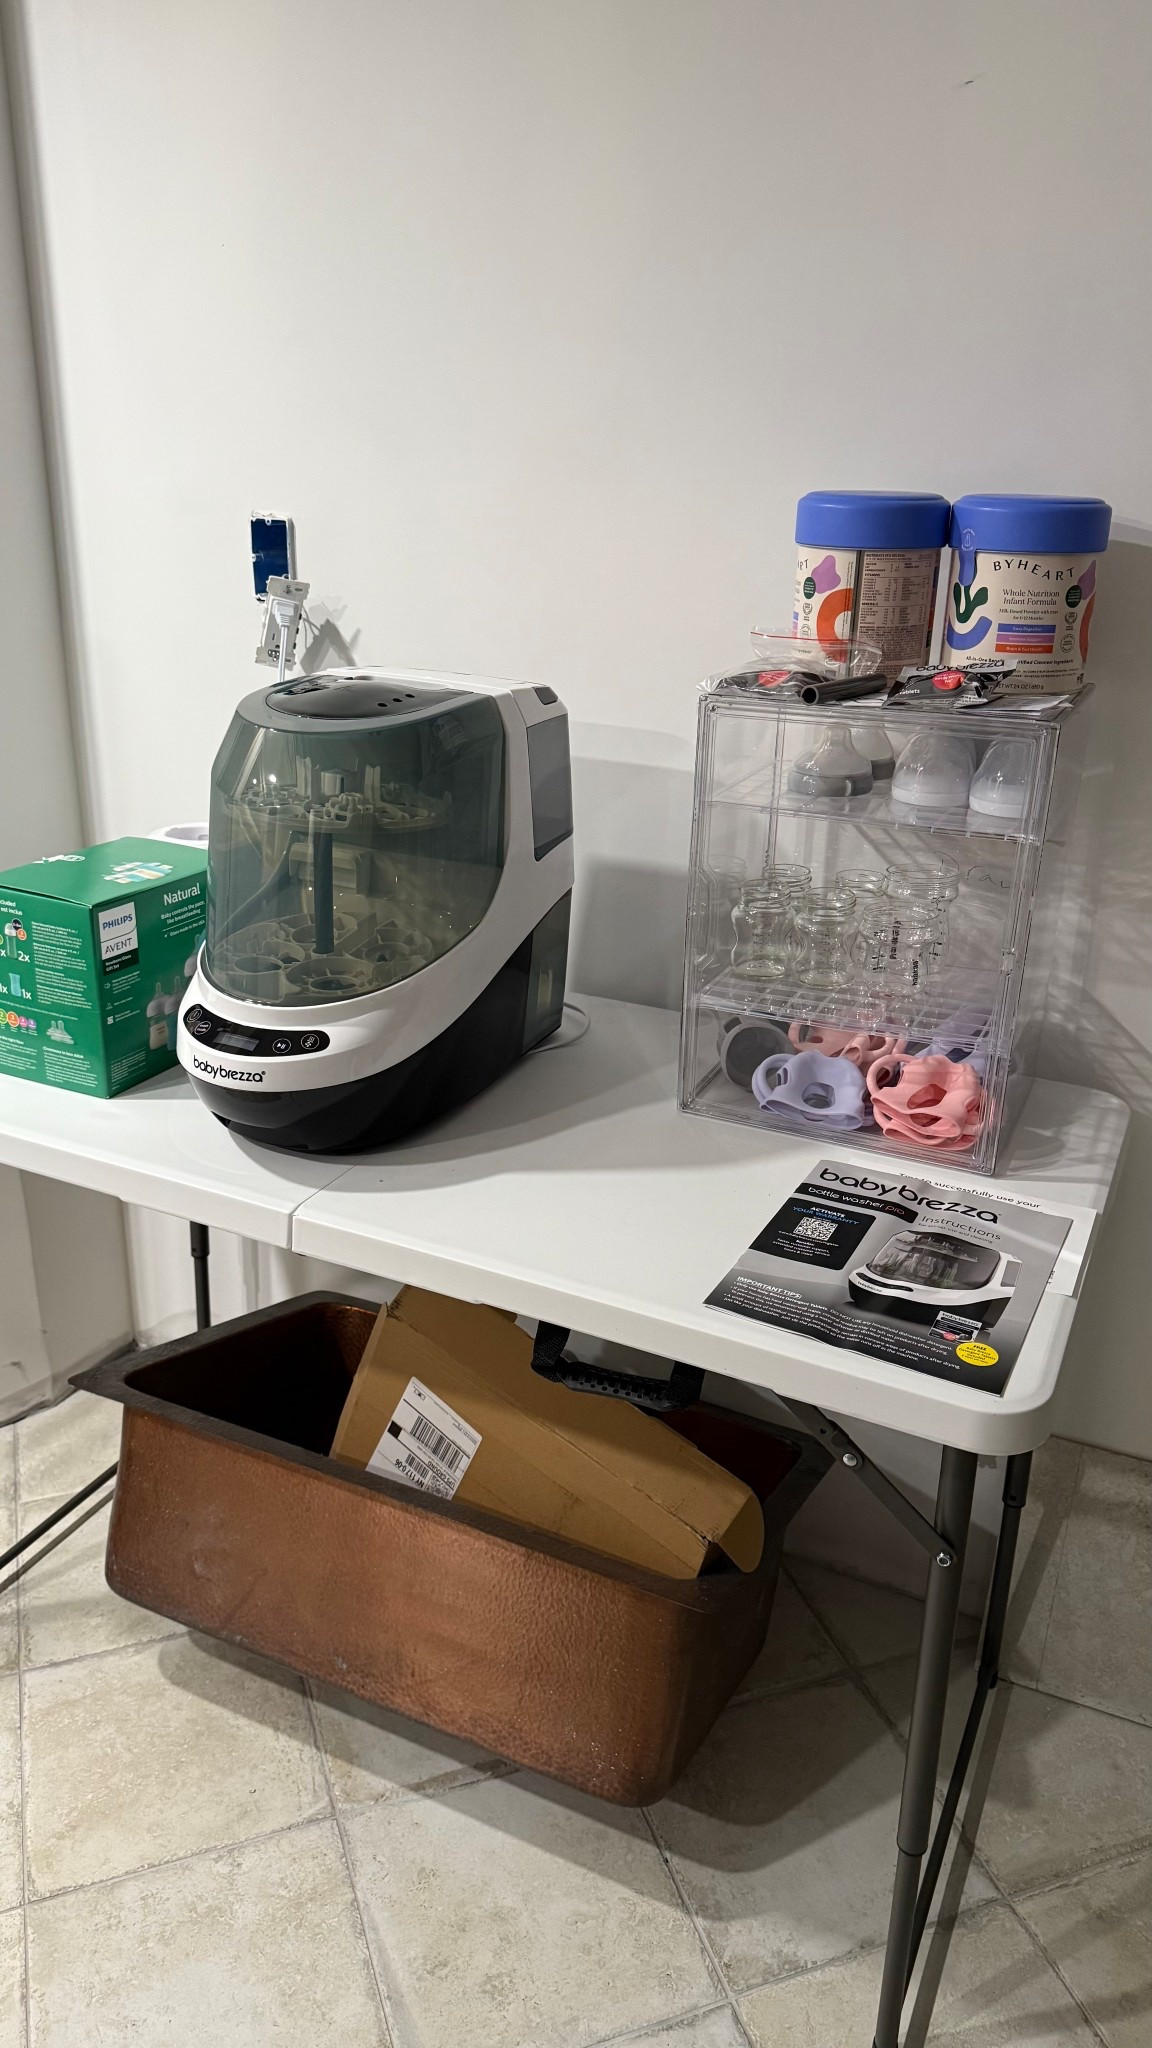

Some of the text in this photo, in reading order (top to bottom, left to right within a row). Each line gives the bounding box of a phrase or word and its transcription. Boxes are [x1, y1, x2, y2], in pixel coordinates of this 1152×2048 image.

[993, 558, 1075, 581] BYHEART
[1002, 588, 1026, 598] Whole
[1026, 588, 1060, 599] Nutrition
[1003, 597, 1057, 606] Infant Formula
[163, 883, 201, 906] Natural
[102, 913, 134, 931] PHILIPS
[160, 912, 172, 920] Baby
[171, 907, 188, 916] controls
[104, 937, 133, 955] AVENT
[18, 950, 31, 963] 2x
[21, 988, 32, 1000] 1x
[808, 1186, 905, 1216] bottle washer pro
[934, 1181, 994, 1199] successfully
[996, 1194, 1014, 1202] use
[1016, 1199, 1042, 1209] your
[810, 1207, 846, 1218] ACTIVATE
[921, 1215, 1002, 1241] Instructions
[736, 1276, 784, 1294] IMPORTANT
[427, 1460, 456, 1488] UPS GROUND
[415, 1478, 426, 1489] NY
